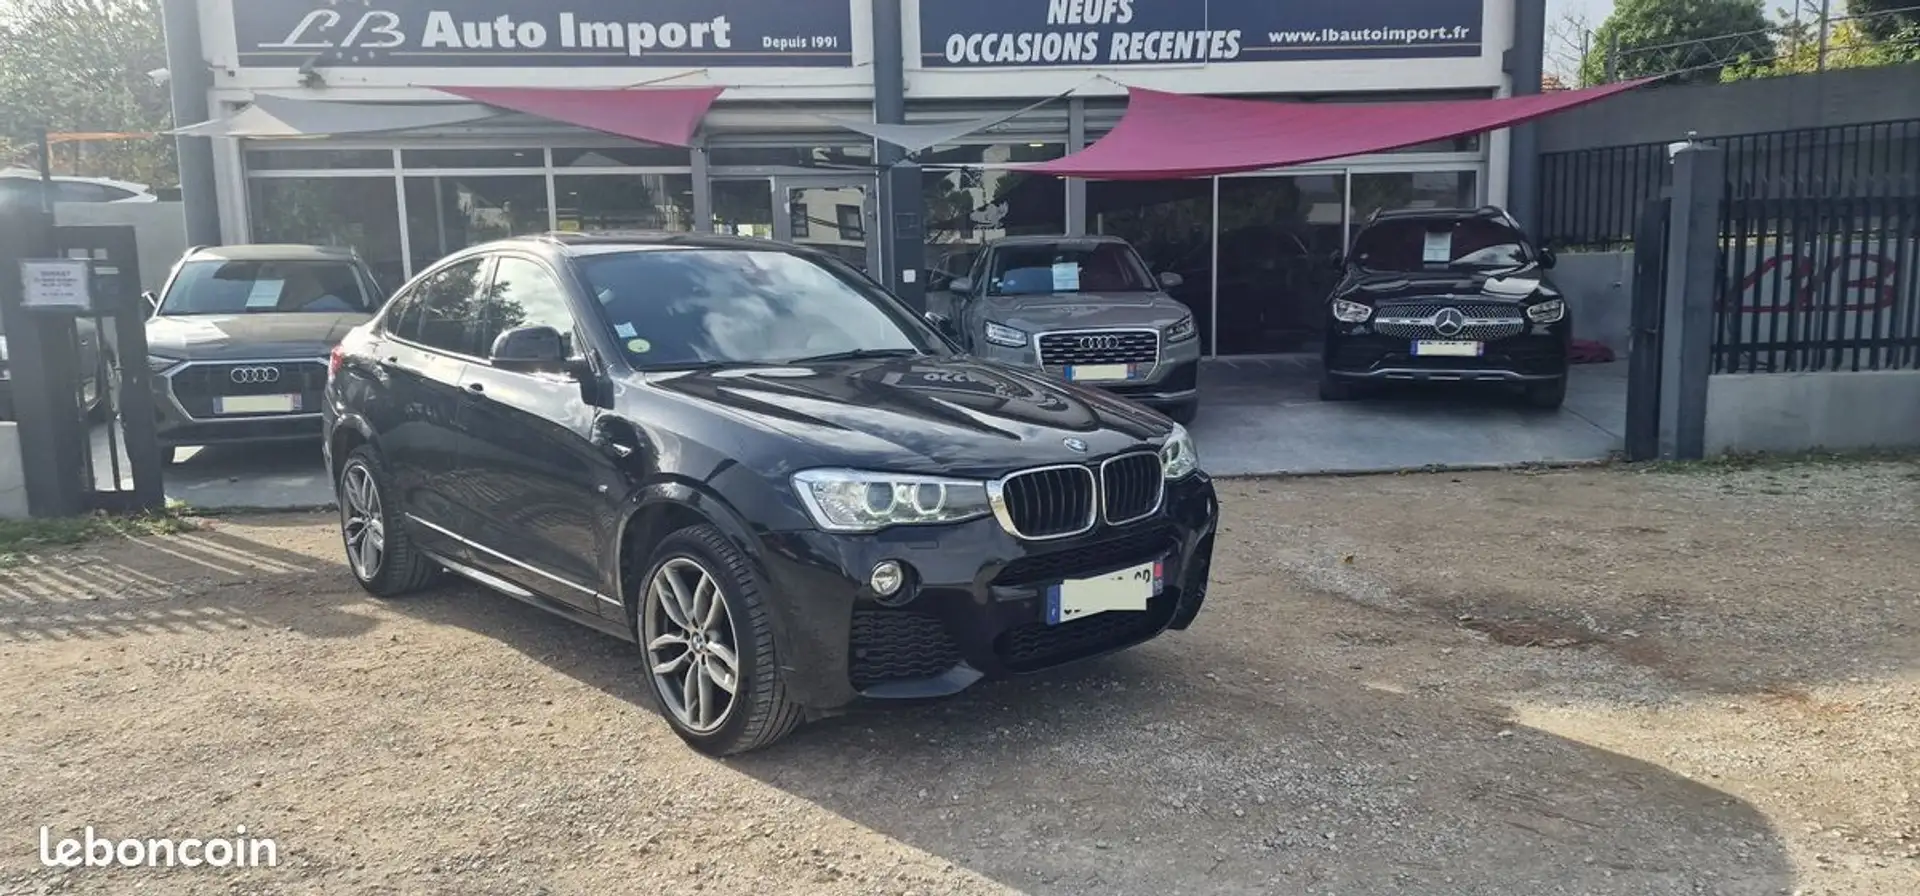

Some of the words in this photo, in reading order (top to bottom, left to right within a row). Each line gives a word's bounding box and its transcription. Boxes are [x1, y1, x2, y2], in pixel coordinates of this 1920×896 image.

[1046, 0, 1134, 25] NEUFS
[421, 10, 547, 49] Auto
[560, 10, 732, 57] Import
[762, 36, 807, 50] Depuis
[810, 36, 838, 48] 1991
[1268, 25, 1470, 44] www.lbautoimport.fr
[945, 32, 1100, 63] OCCASIONS
[1108, 30, 1242, 61] RECENTES
